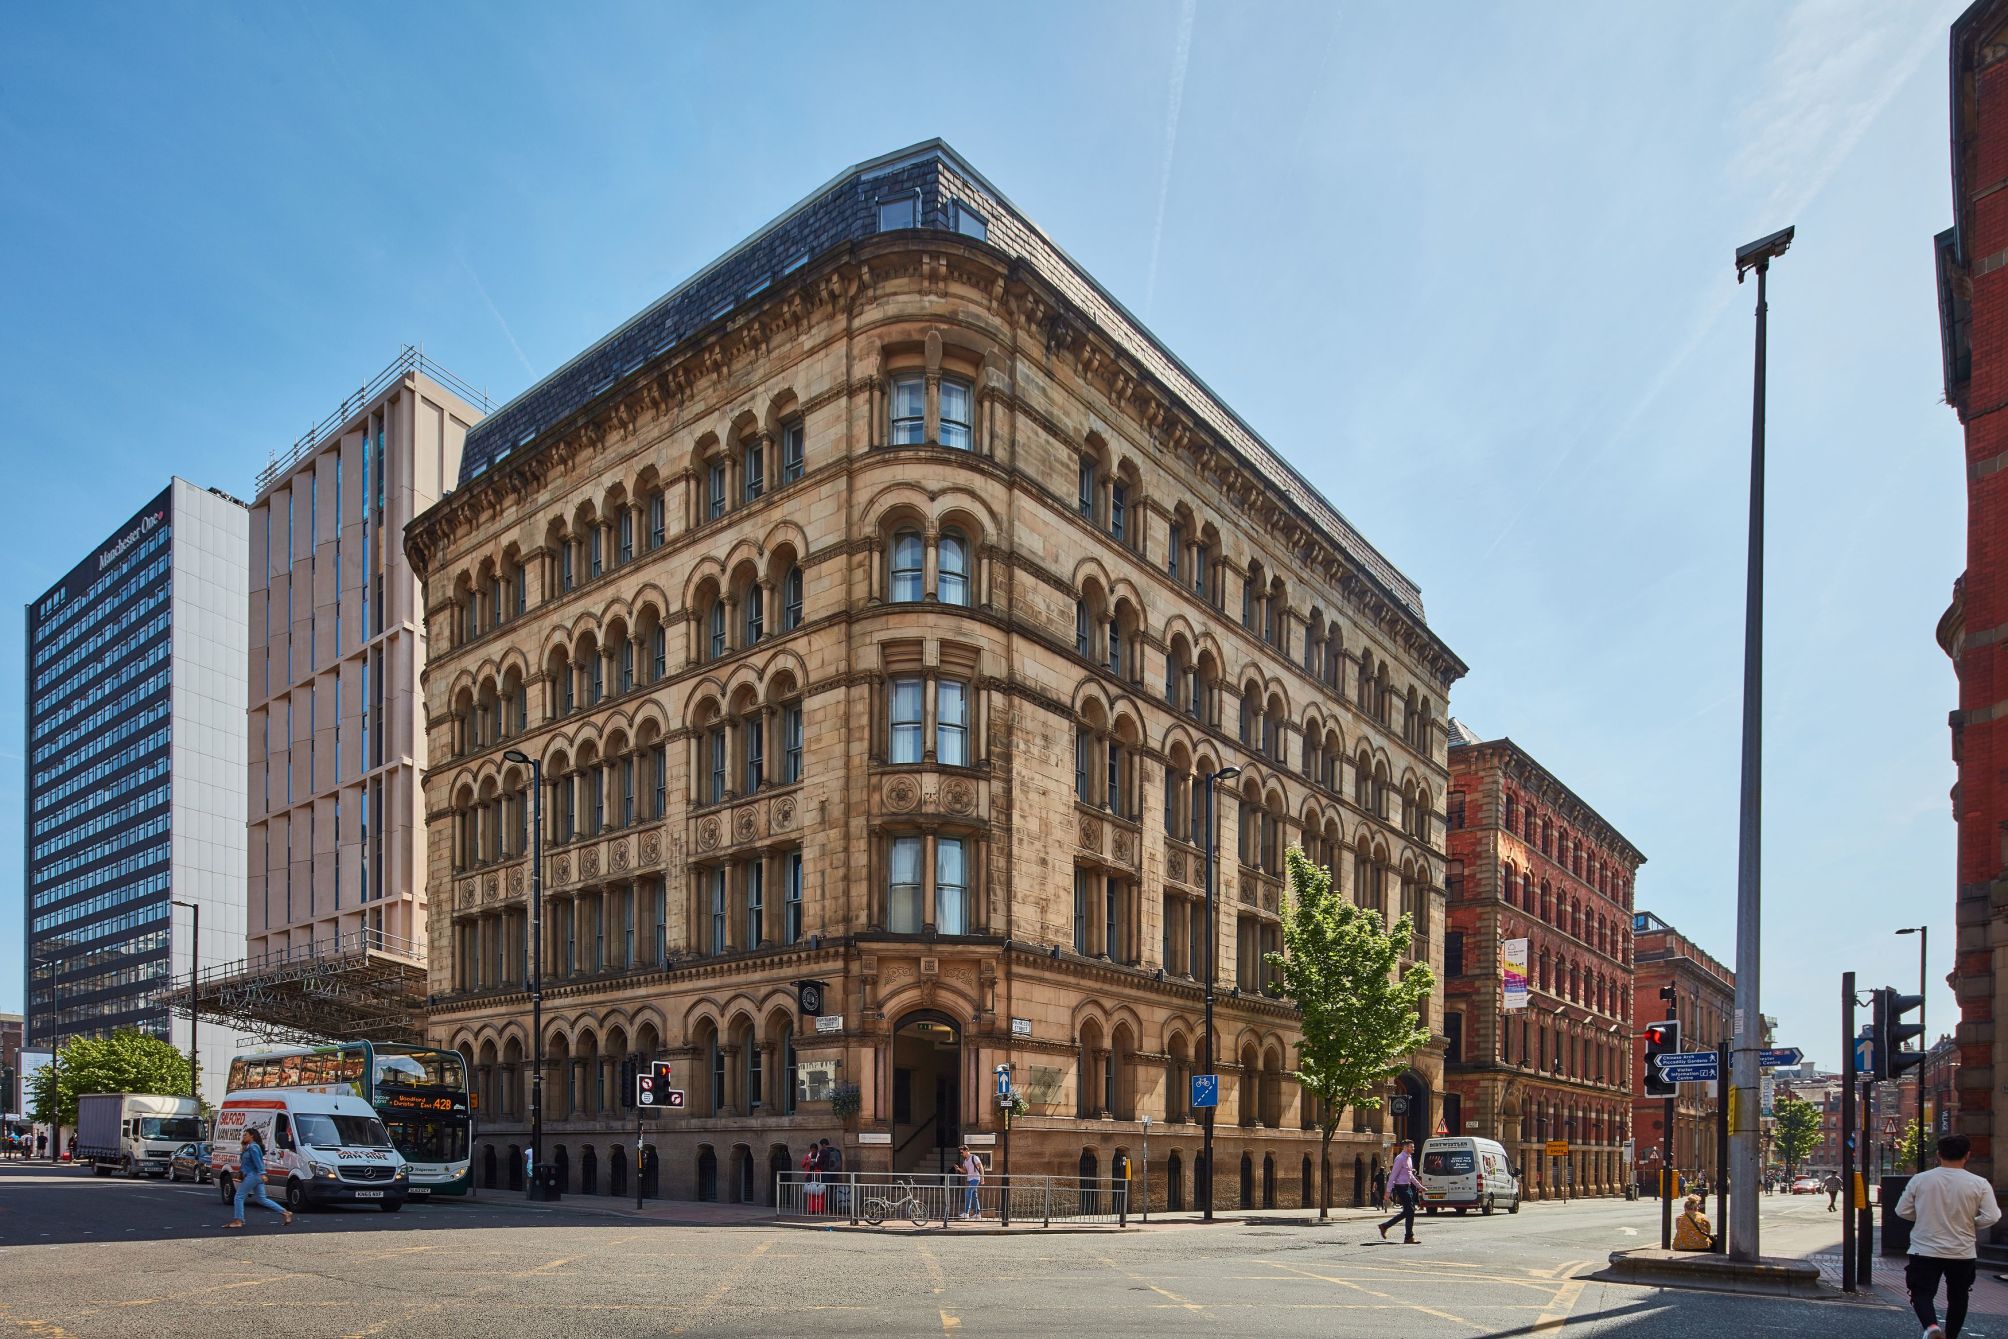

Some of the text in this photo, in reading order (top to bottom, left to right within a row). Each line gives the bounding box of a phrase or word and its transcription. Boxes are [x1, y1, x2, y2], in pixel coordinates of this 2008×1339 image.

[99, 513, 158, 571] Manchester One
[220, 1111, 246, 1126] SALFORD
[217, 1128, 229, 1141] VAN
